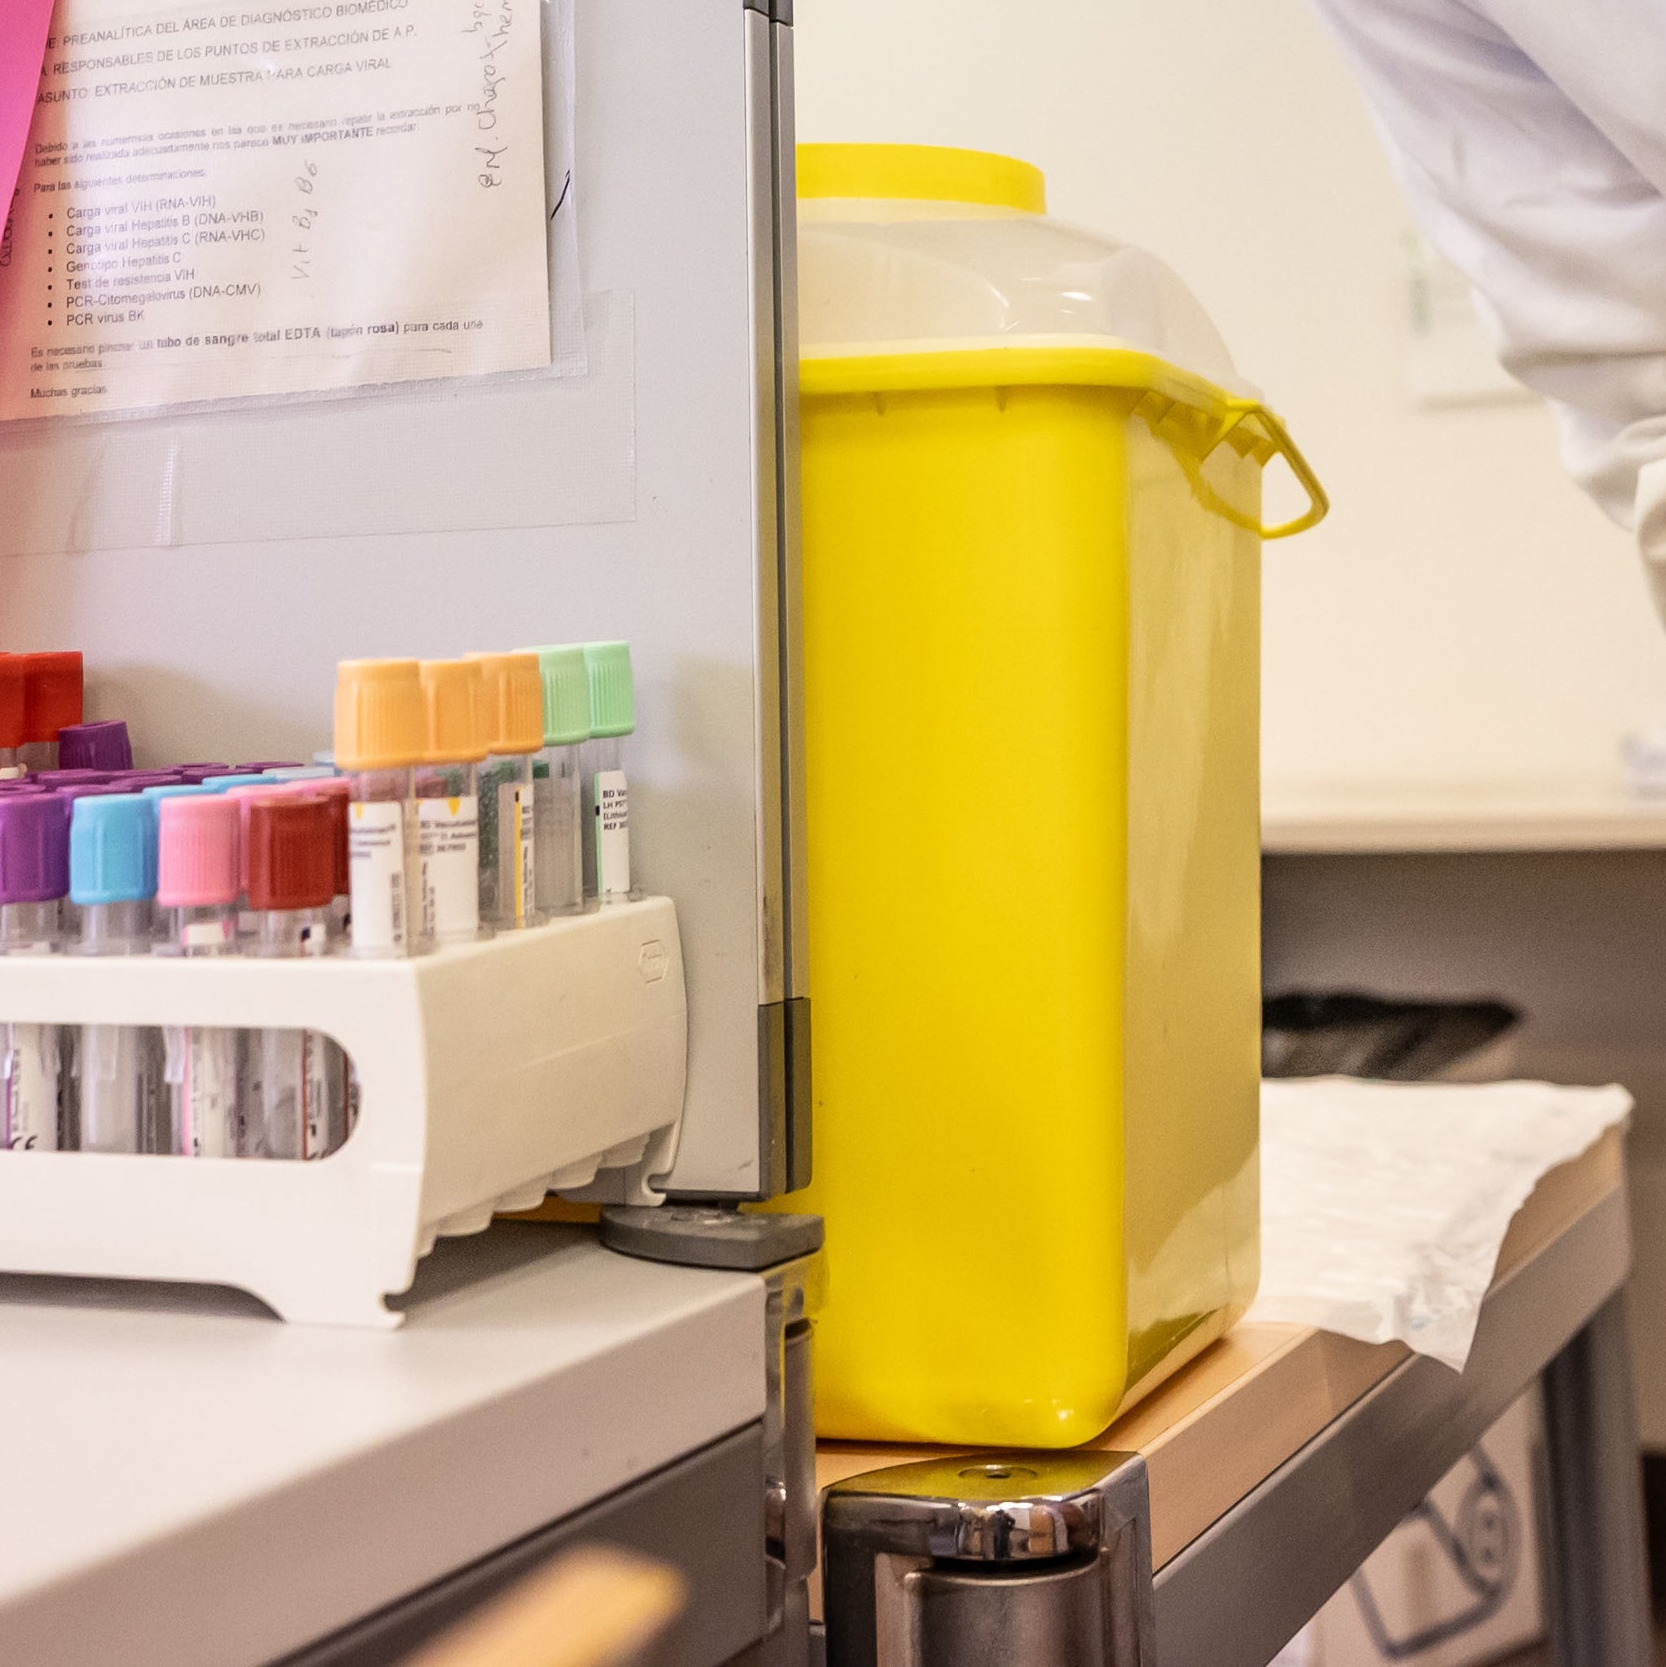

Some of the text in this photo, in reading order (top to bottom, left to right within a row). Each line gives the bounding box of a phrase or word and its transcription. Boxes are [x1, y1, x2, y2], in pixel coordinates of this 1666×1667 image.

[63, 25, 152, 47] PREANALÍTICA
[156, 21, 179, 35] DEL
[183, 15, 216, 32] ÁREA
[220, 14, 237, 28] DE
[241, 5, 333, 27] DIAGNÓSTICO
[53, 51, 154, 76] RESPONSABLES
[157, 49, 174, 62] DE
[177, 46, 202, 60] LOS
[205, 41, 259, 58] PUNTOS
[263, 40, 281, 53] DE
[284, 29, 369, 52] EXTRACCIÓN
[372, 28, 390, 42] DE
[95, 77, 176, 97] EXTRACCIÓN
[179, 75, 196, 88] DE
[200, 70, 263, 87] MUESTRA
[307, 61, 353, 78] CARGA
[356, 57, 392, 72] VIRAL
[35, 142, 68, 155] Debido
[101, 134, 155, 147] numerosas
[158, 128, 206, 140] ocasiones
[211, 127, 223, 136] en
[228, 125, 242, 135] las
[377, 111, 386, 122] la
[445, 104, 462, 116] por
[467, 101, 480, 112] no
[34, 155, 61, 168] haber
[63, 153, 84, 164] sido
[213, 140, 231, 150] nos
[272, 134, 297, 147] MUY
[300, 127, 374, 145] IMPORTANTE
[33, 182, 56, 194] Para
[58, 181, 72, 192] las
[74, 176, 123, 191] siguientes
[66, 195, 217, 220] Carga viral VIH (RNA-VIH)
[66, 209, 265, 237] Carga viral Hepatitis B (DNA-VHB)
[66, 227, 266, 256] Carga viral Hepatitis C (RNA-VHC)
[66, 251, 182, 273] Genotipo Hepatitis C
[66, 268, 196, 290] Test de resistencia VIH
[66, 282, 262, 309] PCR-Citomegalovirus (DNA-CMV)
[66, 309, 146, 327] PCR virus BK
[30, 346, 44, 358] Es
[46, 343, 95, 356] necesario
[157, 336, 182, 348] tubo
[186, 335, 200, 346] de
[204, 332, 249, 347] sangre
[253, 330, 281, 343] total
[285, 327, 321, 340] EDTA
[367, 320, 400, 335] rosa)
[403, 321, 429, 334] para
[433, 318, 460, 331] cada
[30, 359, 102, 372] de las pruebas
[30, 384, 108, 399] Muchas gracias
